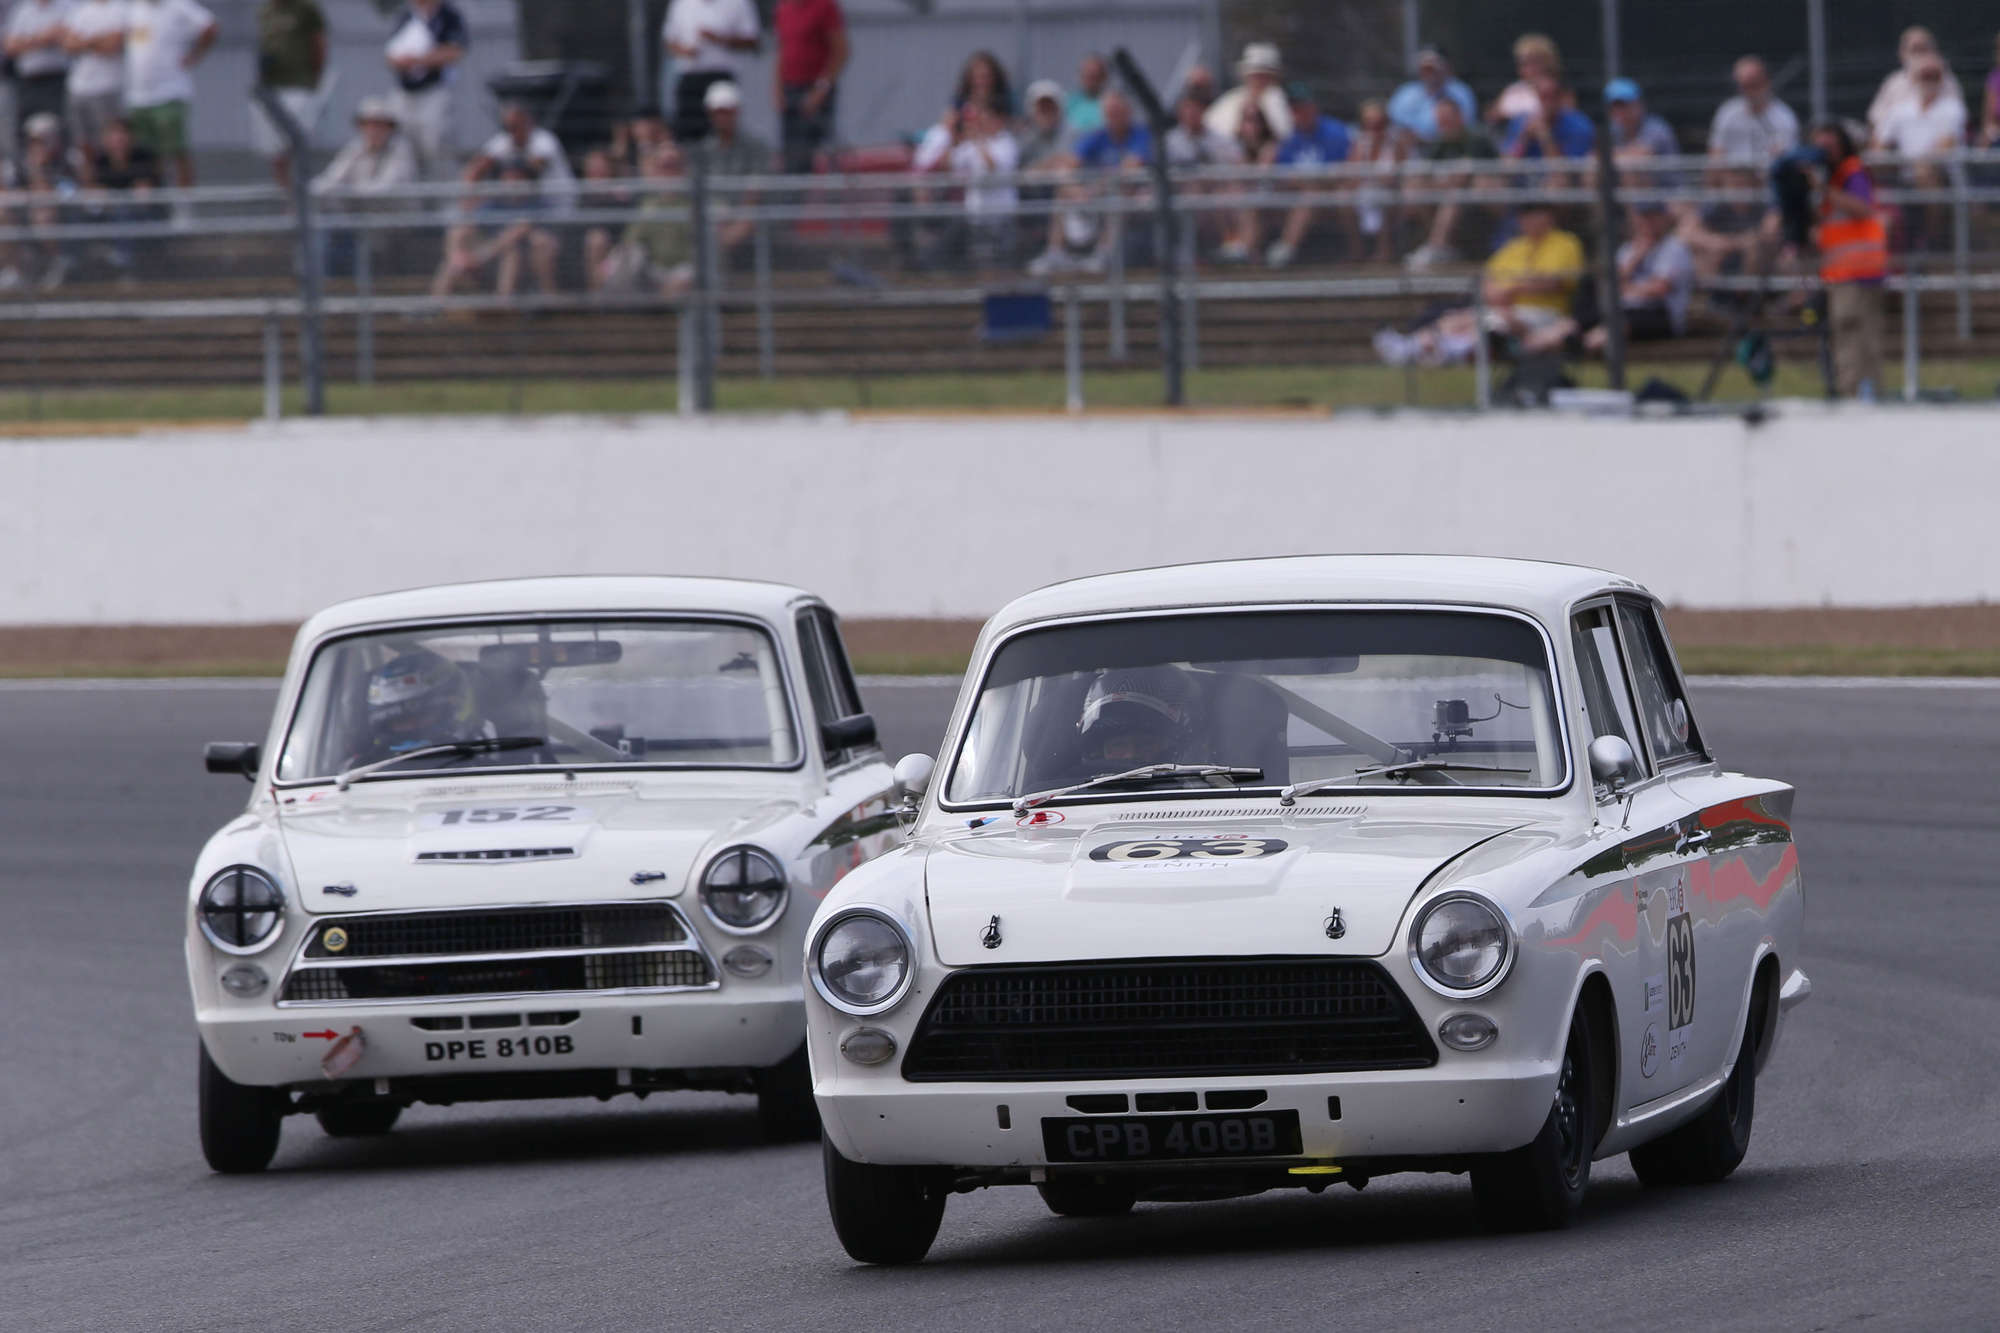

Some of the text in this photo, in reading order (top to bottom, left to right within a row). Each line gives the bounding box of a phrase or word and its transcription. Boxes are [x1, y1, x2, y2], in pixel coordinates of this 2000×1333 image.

[442, 805, 576, 825] 152
[1107, 840, 1266, 861] 63
[1119, 862, 1230, 870] ZENITH
[1669, 919, 1693, 1028] 63
[424, 1034, 575, 1061] DPE 810B
[1065, 1117, 1277, 1158] CPB 408B
